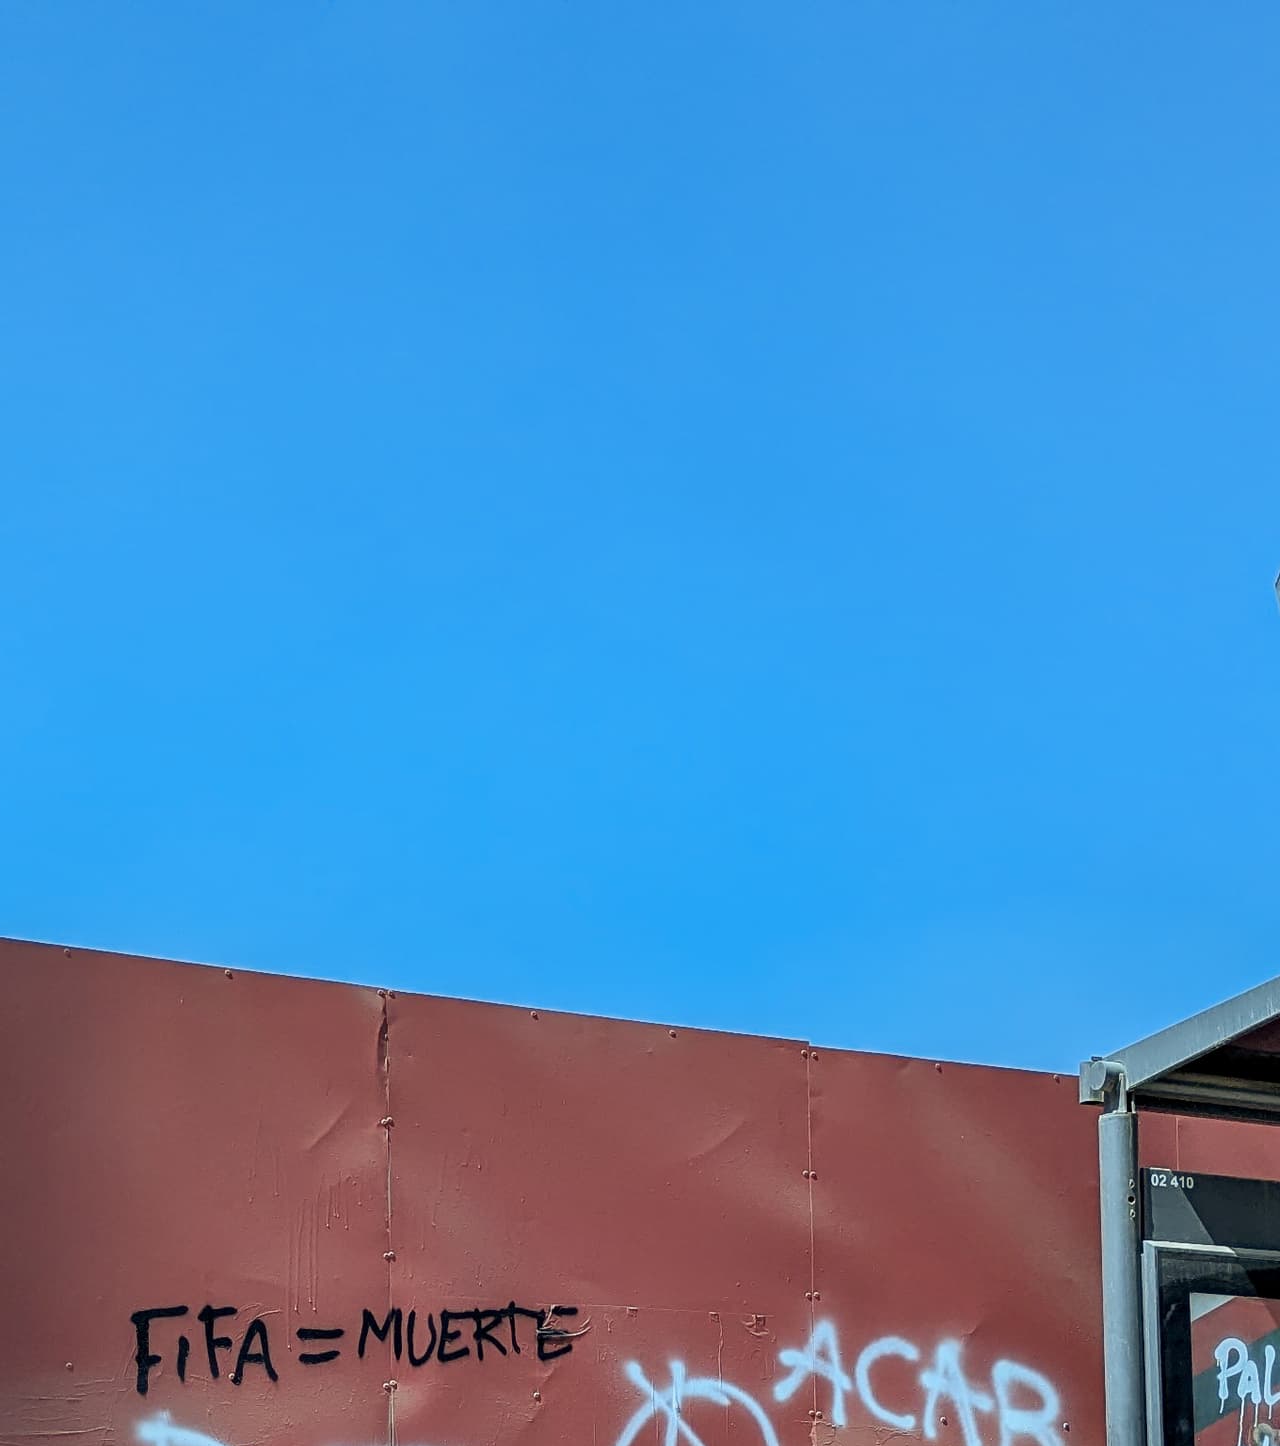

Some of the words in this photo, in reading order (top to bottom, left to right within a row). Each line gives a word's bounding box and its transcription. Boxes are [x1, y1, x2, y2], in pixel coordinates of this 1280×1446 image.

[1150, 1174, 1167, 1187] 02
[1170, 1176, 1194, 1189] 410
[357, 1303, 581, 1367] MUERTE
